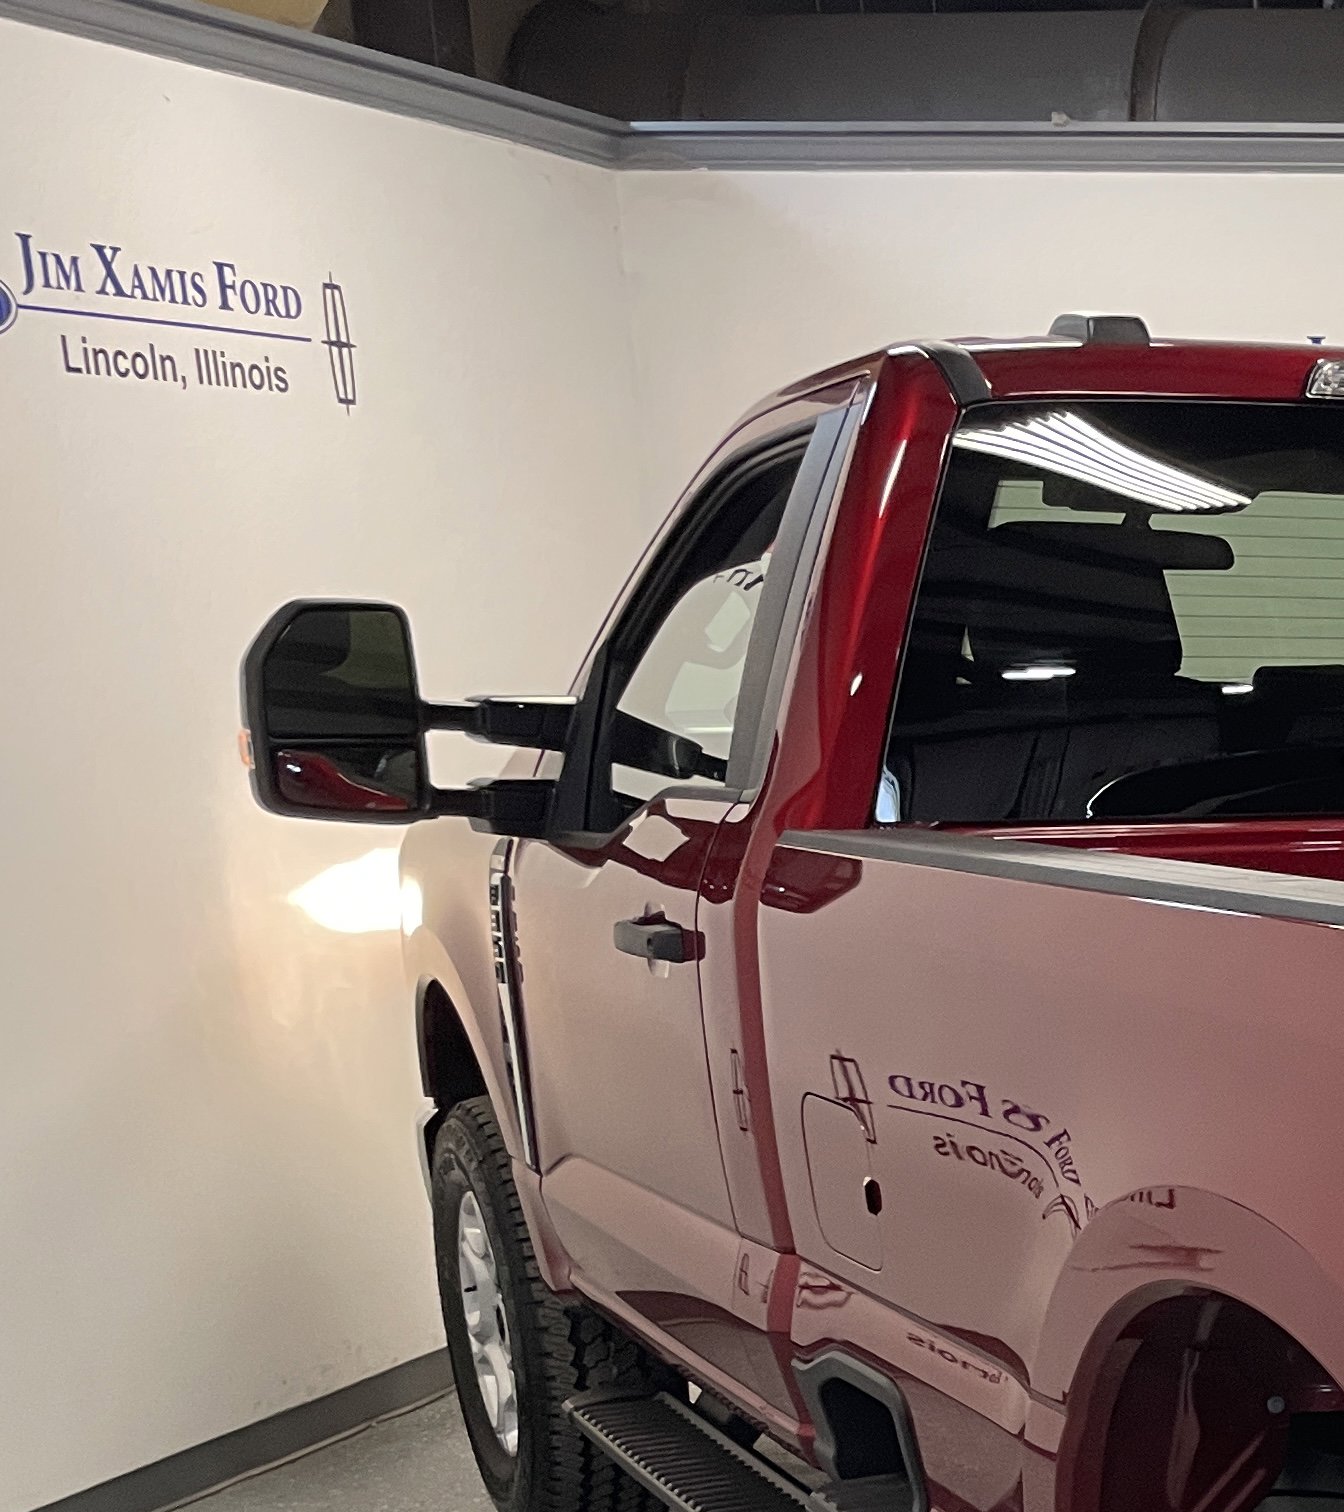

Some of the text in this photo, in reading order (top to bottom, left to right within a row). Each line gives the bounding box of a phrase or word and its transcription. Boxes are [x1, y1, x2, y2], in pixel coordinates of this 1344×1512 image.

[15, 232, 301, 320] JIM XAMIS FORD
[60, 335, 289, 393] Lincoln, Illinois
